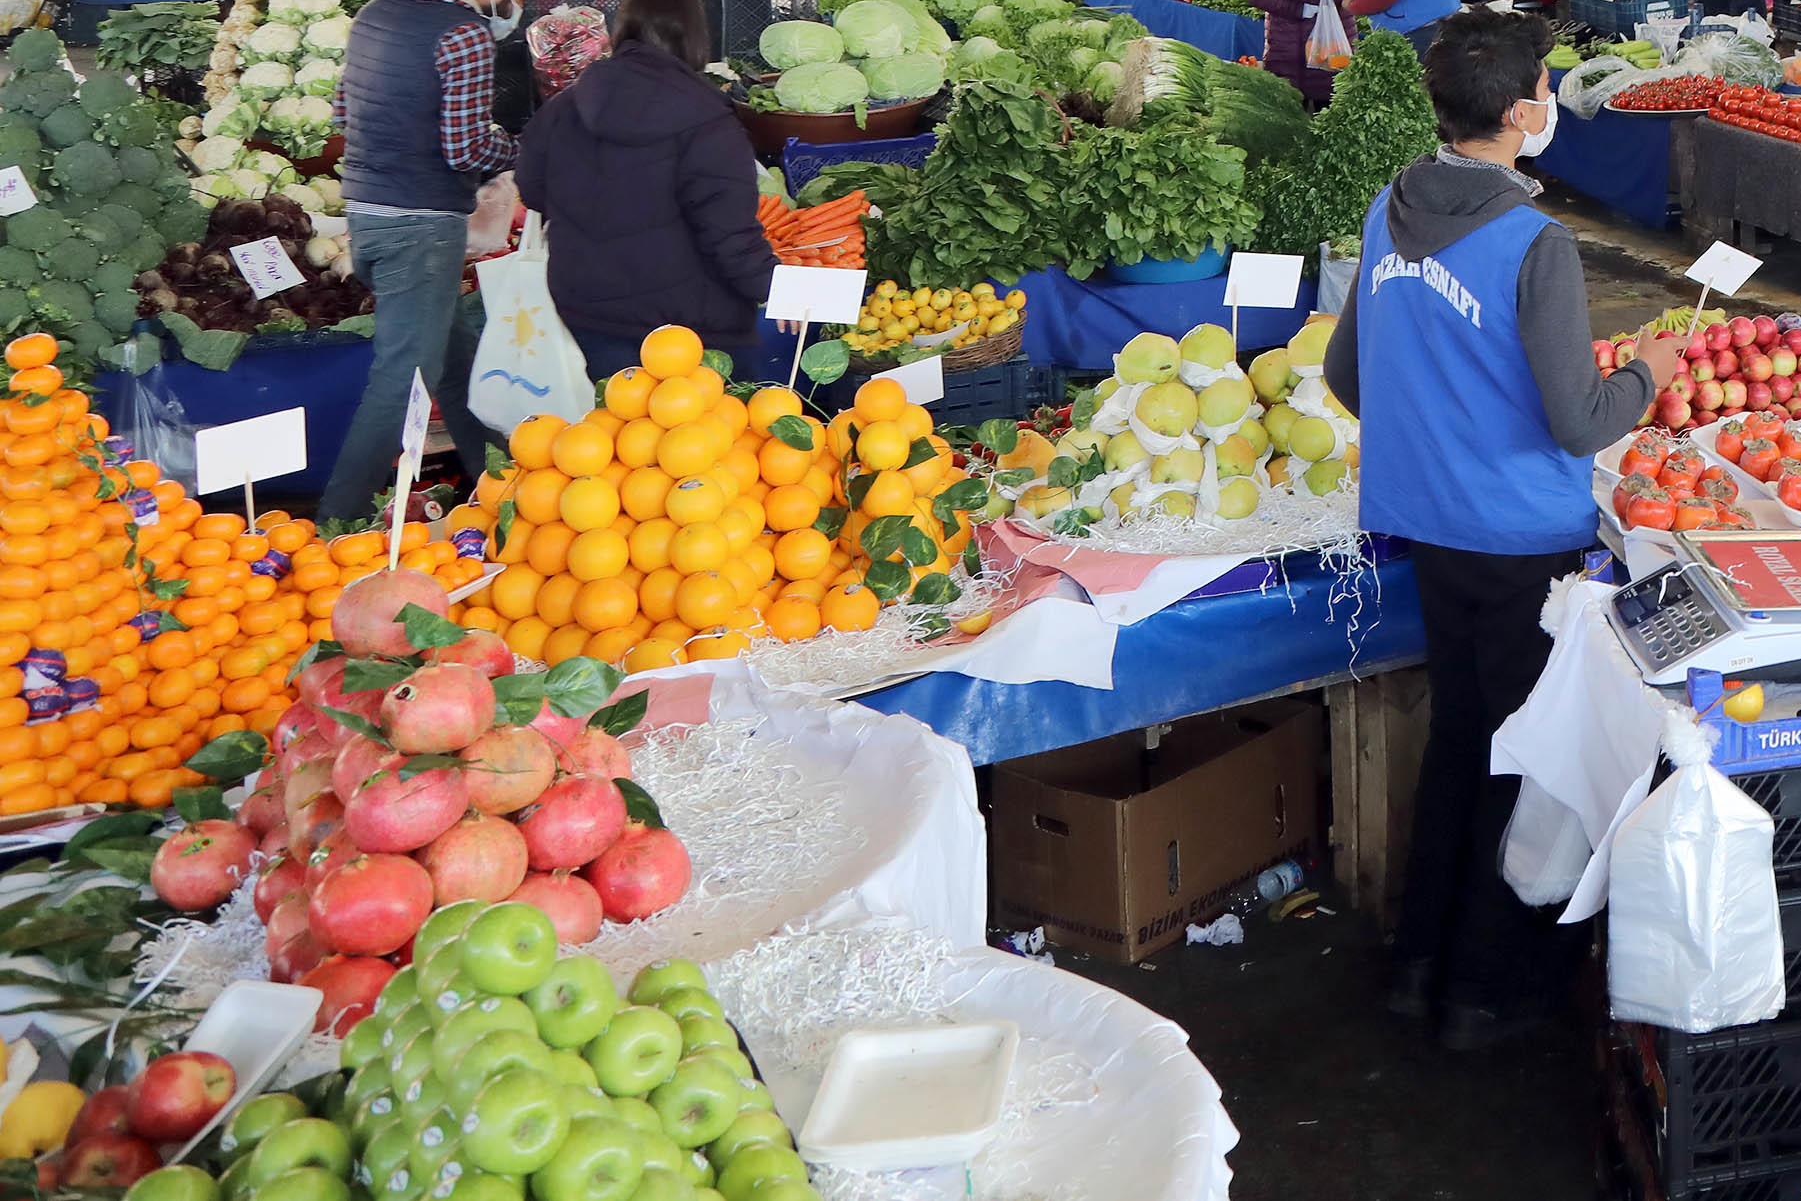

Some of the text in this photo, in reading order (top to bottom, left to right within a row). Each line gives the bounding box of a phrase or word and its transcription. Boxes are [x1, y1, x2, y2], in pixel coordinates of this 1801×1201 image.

[1422, 256, 1481, 329] ESNAFI
[1752, 545, 1796, 580] ROYAL
[1137, 908, 1184, 945] BİZİM
